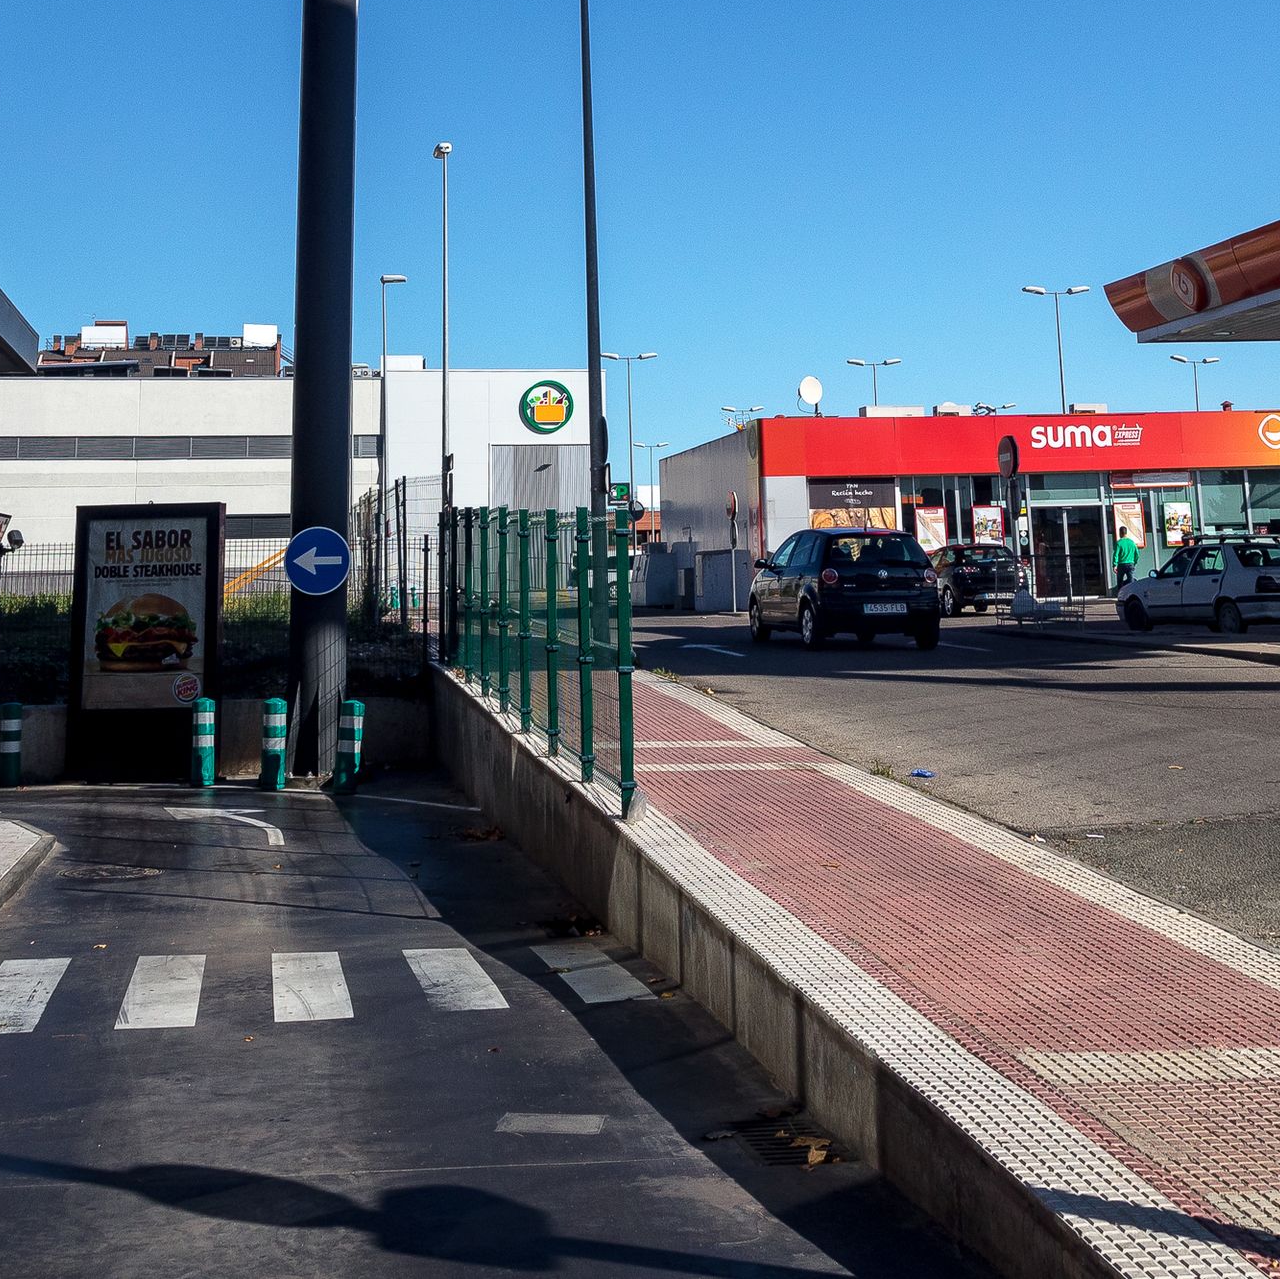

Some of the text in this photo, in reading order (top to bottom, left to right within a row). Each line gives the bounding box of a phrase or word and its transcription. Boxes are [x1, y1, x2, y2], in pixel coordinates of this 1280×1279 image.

[1114, 430, 1140, 439] EXPRESS
[106, 529, 193, 550] EL SABOR
[141, 547, 193, 563] JUGOSO
[94, 563, 202, 579] DOBLE STEAKHOUSE
